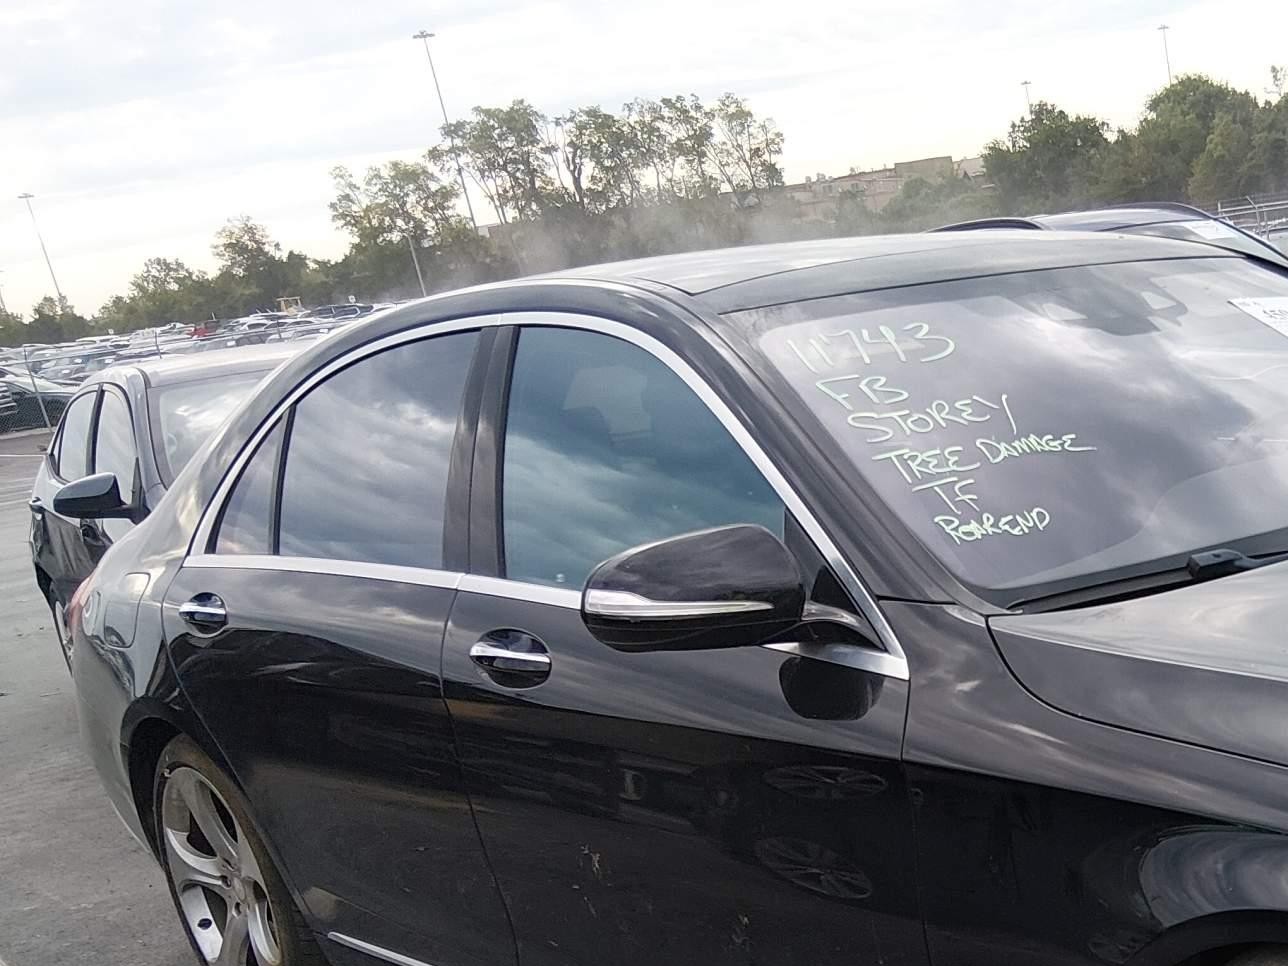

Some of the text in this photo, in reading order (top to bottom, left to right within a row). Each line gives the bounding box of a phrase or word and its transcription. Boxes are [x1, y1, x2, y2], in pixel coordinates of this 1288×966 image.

[787, 322, 955, 374] 11743
[816, 374, 909, 411] FB
[847, 394, 1017, 442] STOREY
[872, 433, 1098, 483] TREE DAMAGE
